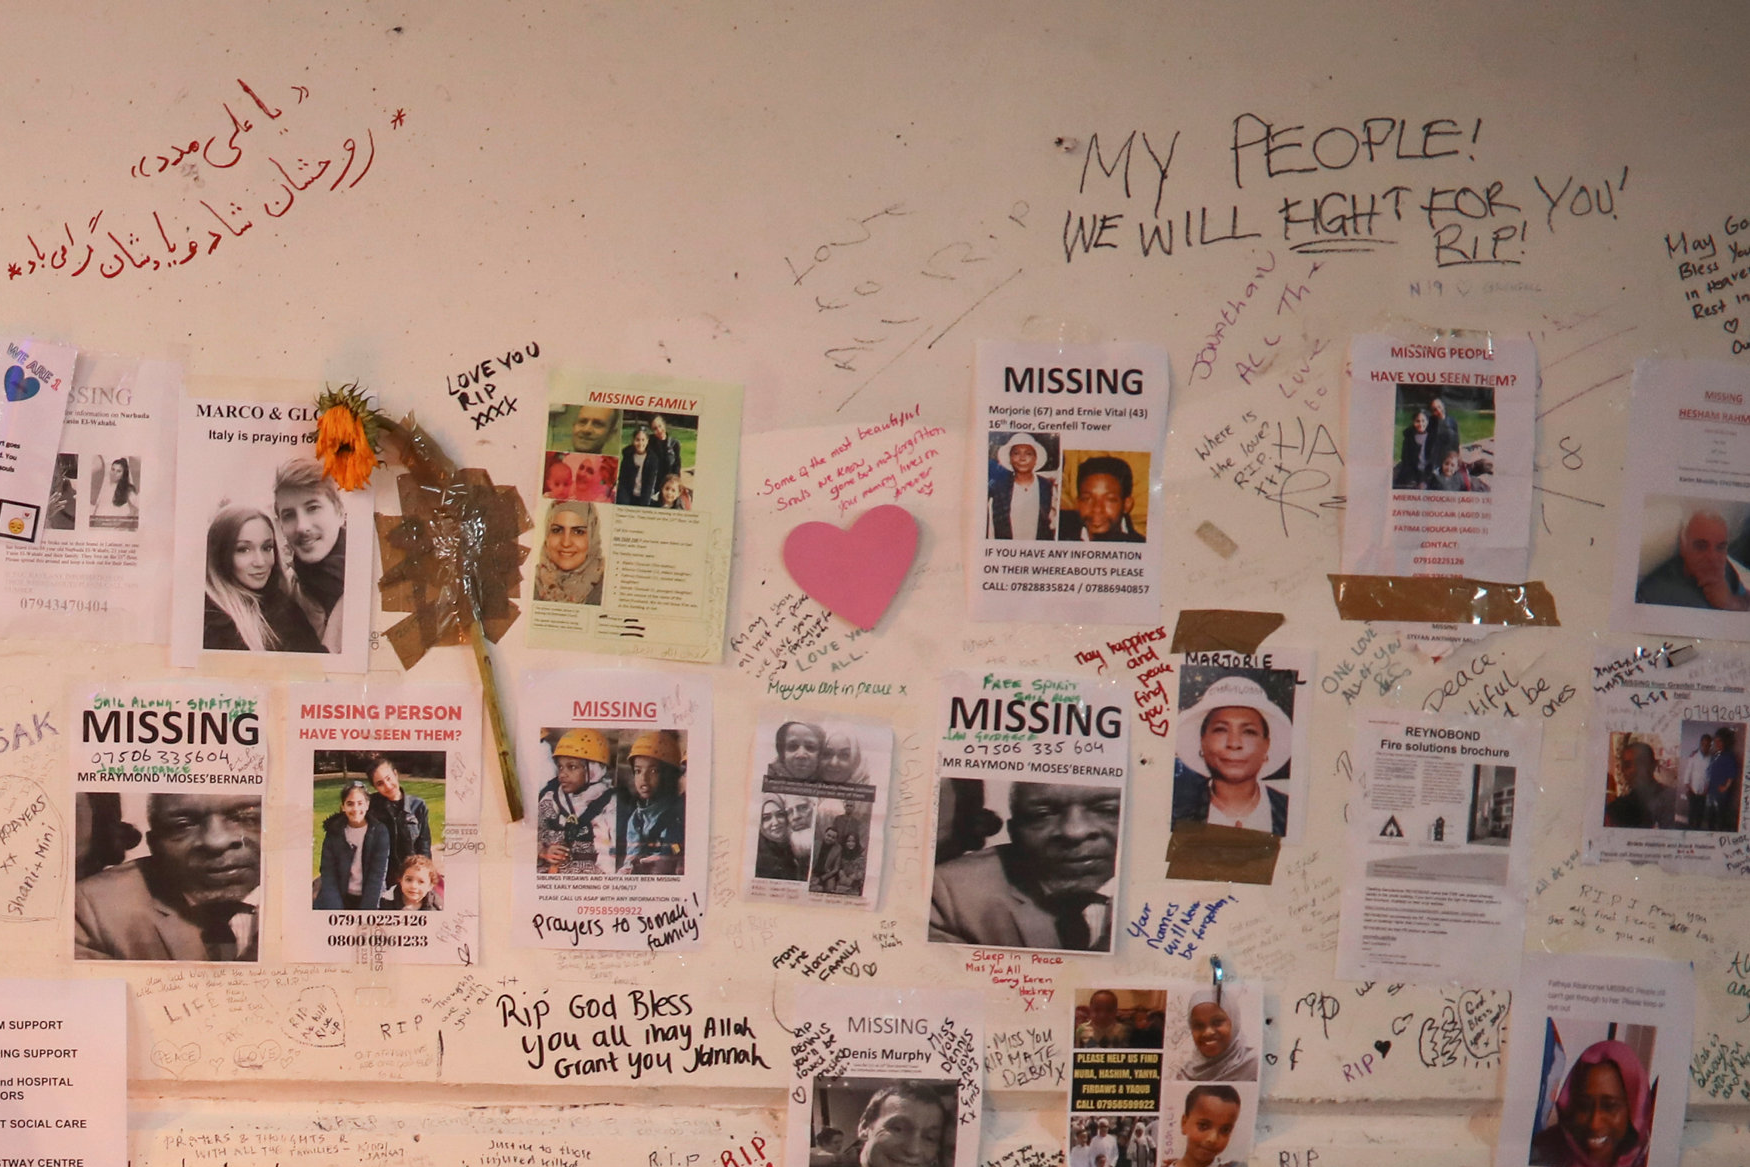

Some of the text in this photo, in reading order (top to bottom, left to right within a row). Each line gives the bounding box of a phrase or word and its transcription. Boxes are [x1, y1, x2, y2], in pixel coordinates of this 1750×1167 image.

[1079, 113, 1481, 217] MY PEOPLE!
[1064, 167, 1629, 263] WE WILL FIGHT FOR YOU!
[1433, 221, 1528, 264] RIP!
[1005, 367, 1143, 394] MISSING
[989, 406, 1148, 418] Morjorie (67) and Ernie Vital (43)
[1010, 421, 1035, 431] floor,
[1038, 422, 1078, 430] Grenfell
[1081, 423, 1111, 431] Tower
[985, 549, 1142, 560] IF YOU HAVE ANY INFORMATION
[984, 566, 1144, 577] ON THEIR WHEREABOUTS PLEASE
[983, 582, 1149, 594] CALL: 07828835824 07886940857
[301, 705, 461, 721] MISSING PERSON
[82, 710, 259, 746] MISSING
[300, 728, 462, 741] HAVE YOU SEEN THEM?
[78, 772, 96, 782] MR
[100, 772, 160, 783] RAYMOND
[570, 994, 617, 1019] God
[628, 990, 693, 1020] Bless
[9, 1021, 63, 1030] SUPPORT
[522, 1032, 581, 1069] you
[593, 1025, 630, 1048] all
[704, 1017, 756, 1039] Allah
[24, 1049, 78, 1058] SUPPORT
[555, 1052, 618, 1078] Grant
[628, 1052, 672, 1078] you
[17, 1078, 73, 1086] HOSPITAL
[10, 1120, 52, 1128] SOCIAL
[55, 1120, 87, 1128] CARE
[38, 1159, 83, 1167] CENTRE
